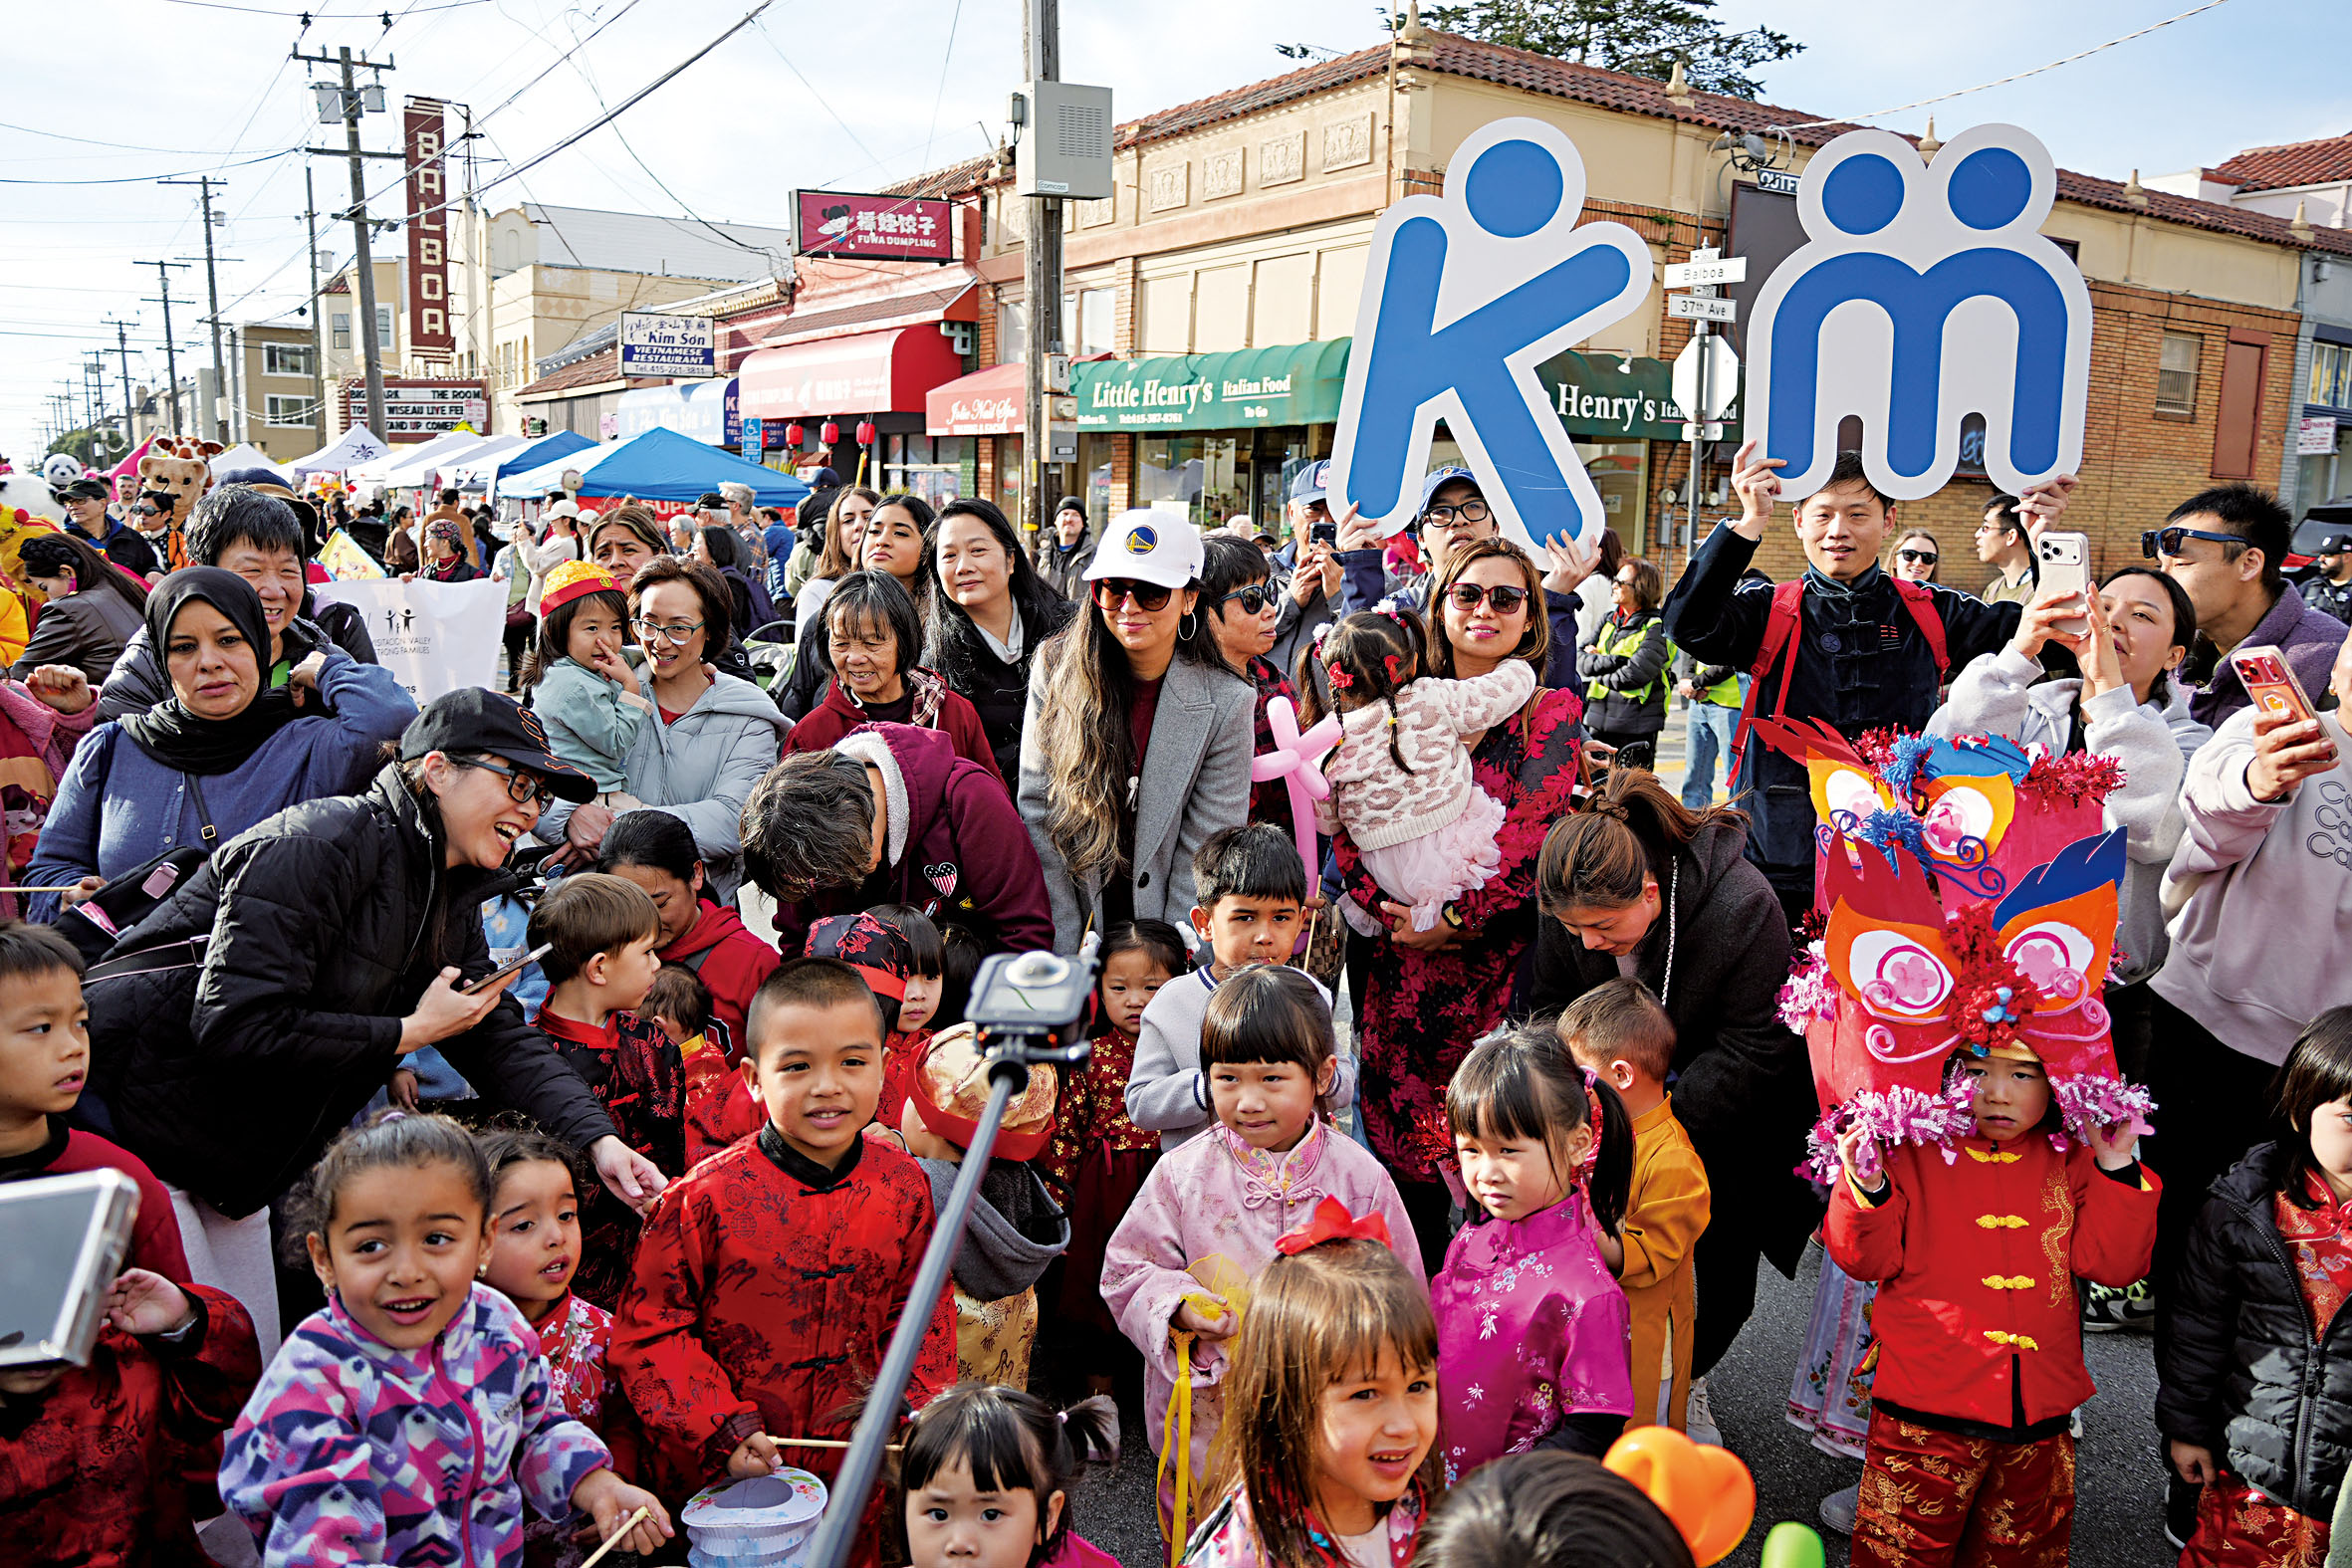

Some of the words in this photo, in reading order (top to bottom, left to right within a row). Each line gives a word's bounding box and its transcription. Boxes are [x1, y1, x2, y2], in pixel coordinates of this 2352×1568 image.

[1760, 171, 1799, 192] OUTF
[417, 131, 445, 336] BALBOA
[857, 234, 885, 246] FUWA
[886, 236, 937, 248] DUMPLING
[1684, 268, 1724, 281] Balboa
[1681, 300, 1705, 314] 37th
[1708, 304, 1727, 317] Ave
[634, 345, 703, 356] VIETNAMESE
[632, 353, 705, 364] RESTAURANT
[1222, 379, 1261, 397] Italian
[1262, 374, 1292, 394] Food
[431, 389, 449, 399] THE
[452, 389, 481, 399] ROOM
[1091, 380, 1140, 408] Little
[1141, 376, 1213, 414] Henry's
[386, 405, 423, 415] WISEAU
[426, 405, 446, 415] LIVE
[1244, 406, 1256, 418] To
[1256, 406, 1268, 418] Go
[1556, 383, 1656, 432] Henry's
[372, 637, 406, 647] ISITACION
[409, 636, 431, 645] VALLEY
[374, 647, 399, 657] TRONG
